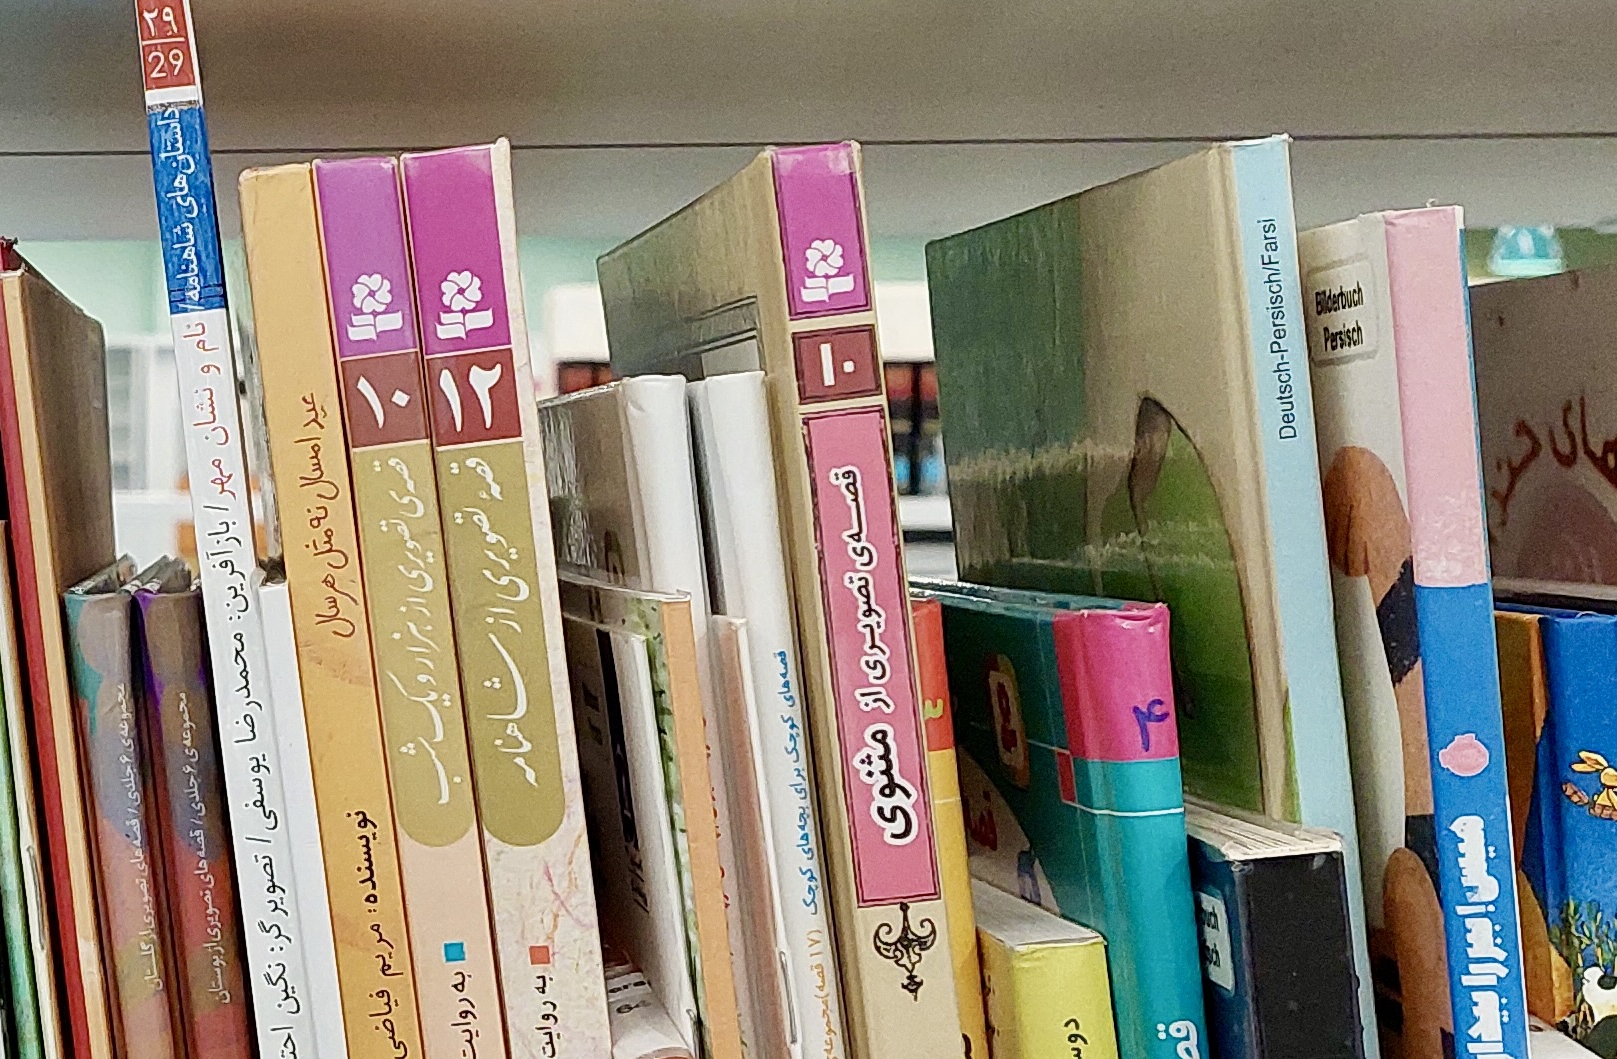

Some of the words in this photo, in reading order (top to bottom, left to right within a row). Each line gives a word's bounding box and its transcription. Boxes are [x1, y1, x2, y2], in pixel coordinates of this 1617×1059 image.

[142, 6, 178, 37] ۲۹
[147, 49, 184, 78] 29
[1315, 282, 1363, 315] Bilderbuch
[1257, 218, 1297, 440] Deutsch-Persisch/Farsi
[1324, 321, 1363, 352] Persisch
[820, 343, 855, 386] ۱۰
[356, 375, 410, 429] ۱۰
[439, 363, 502, 433] ۱۲
[859, 729, 914, 840] مثنوی
[451, 970, 472, 993] به
[534, 974, 554, 995] به
[535, 1000, 561, 1058] روایت
